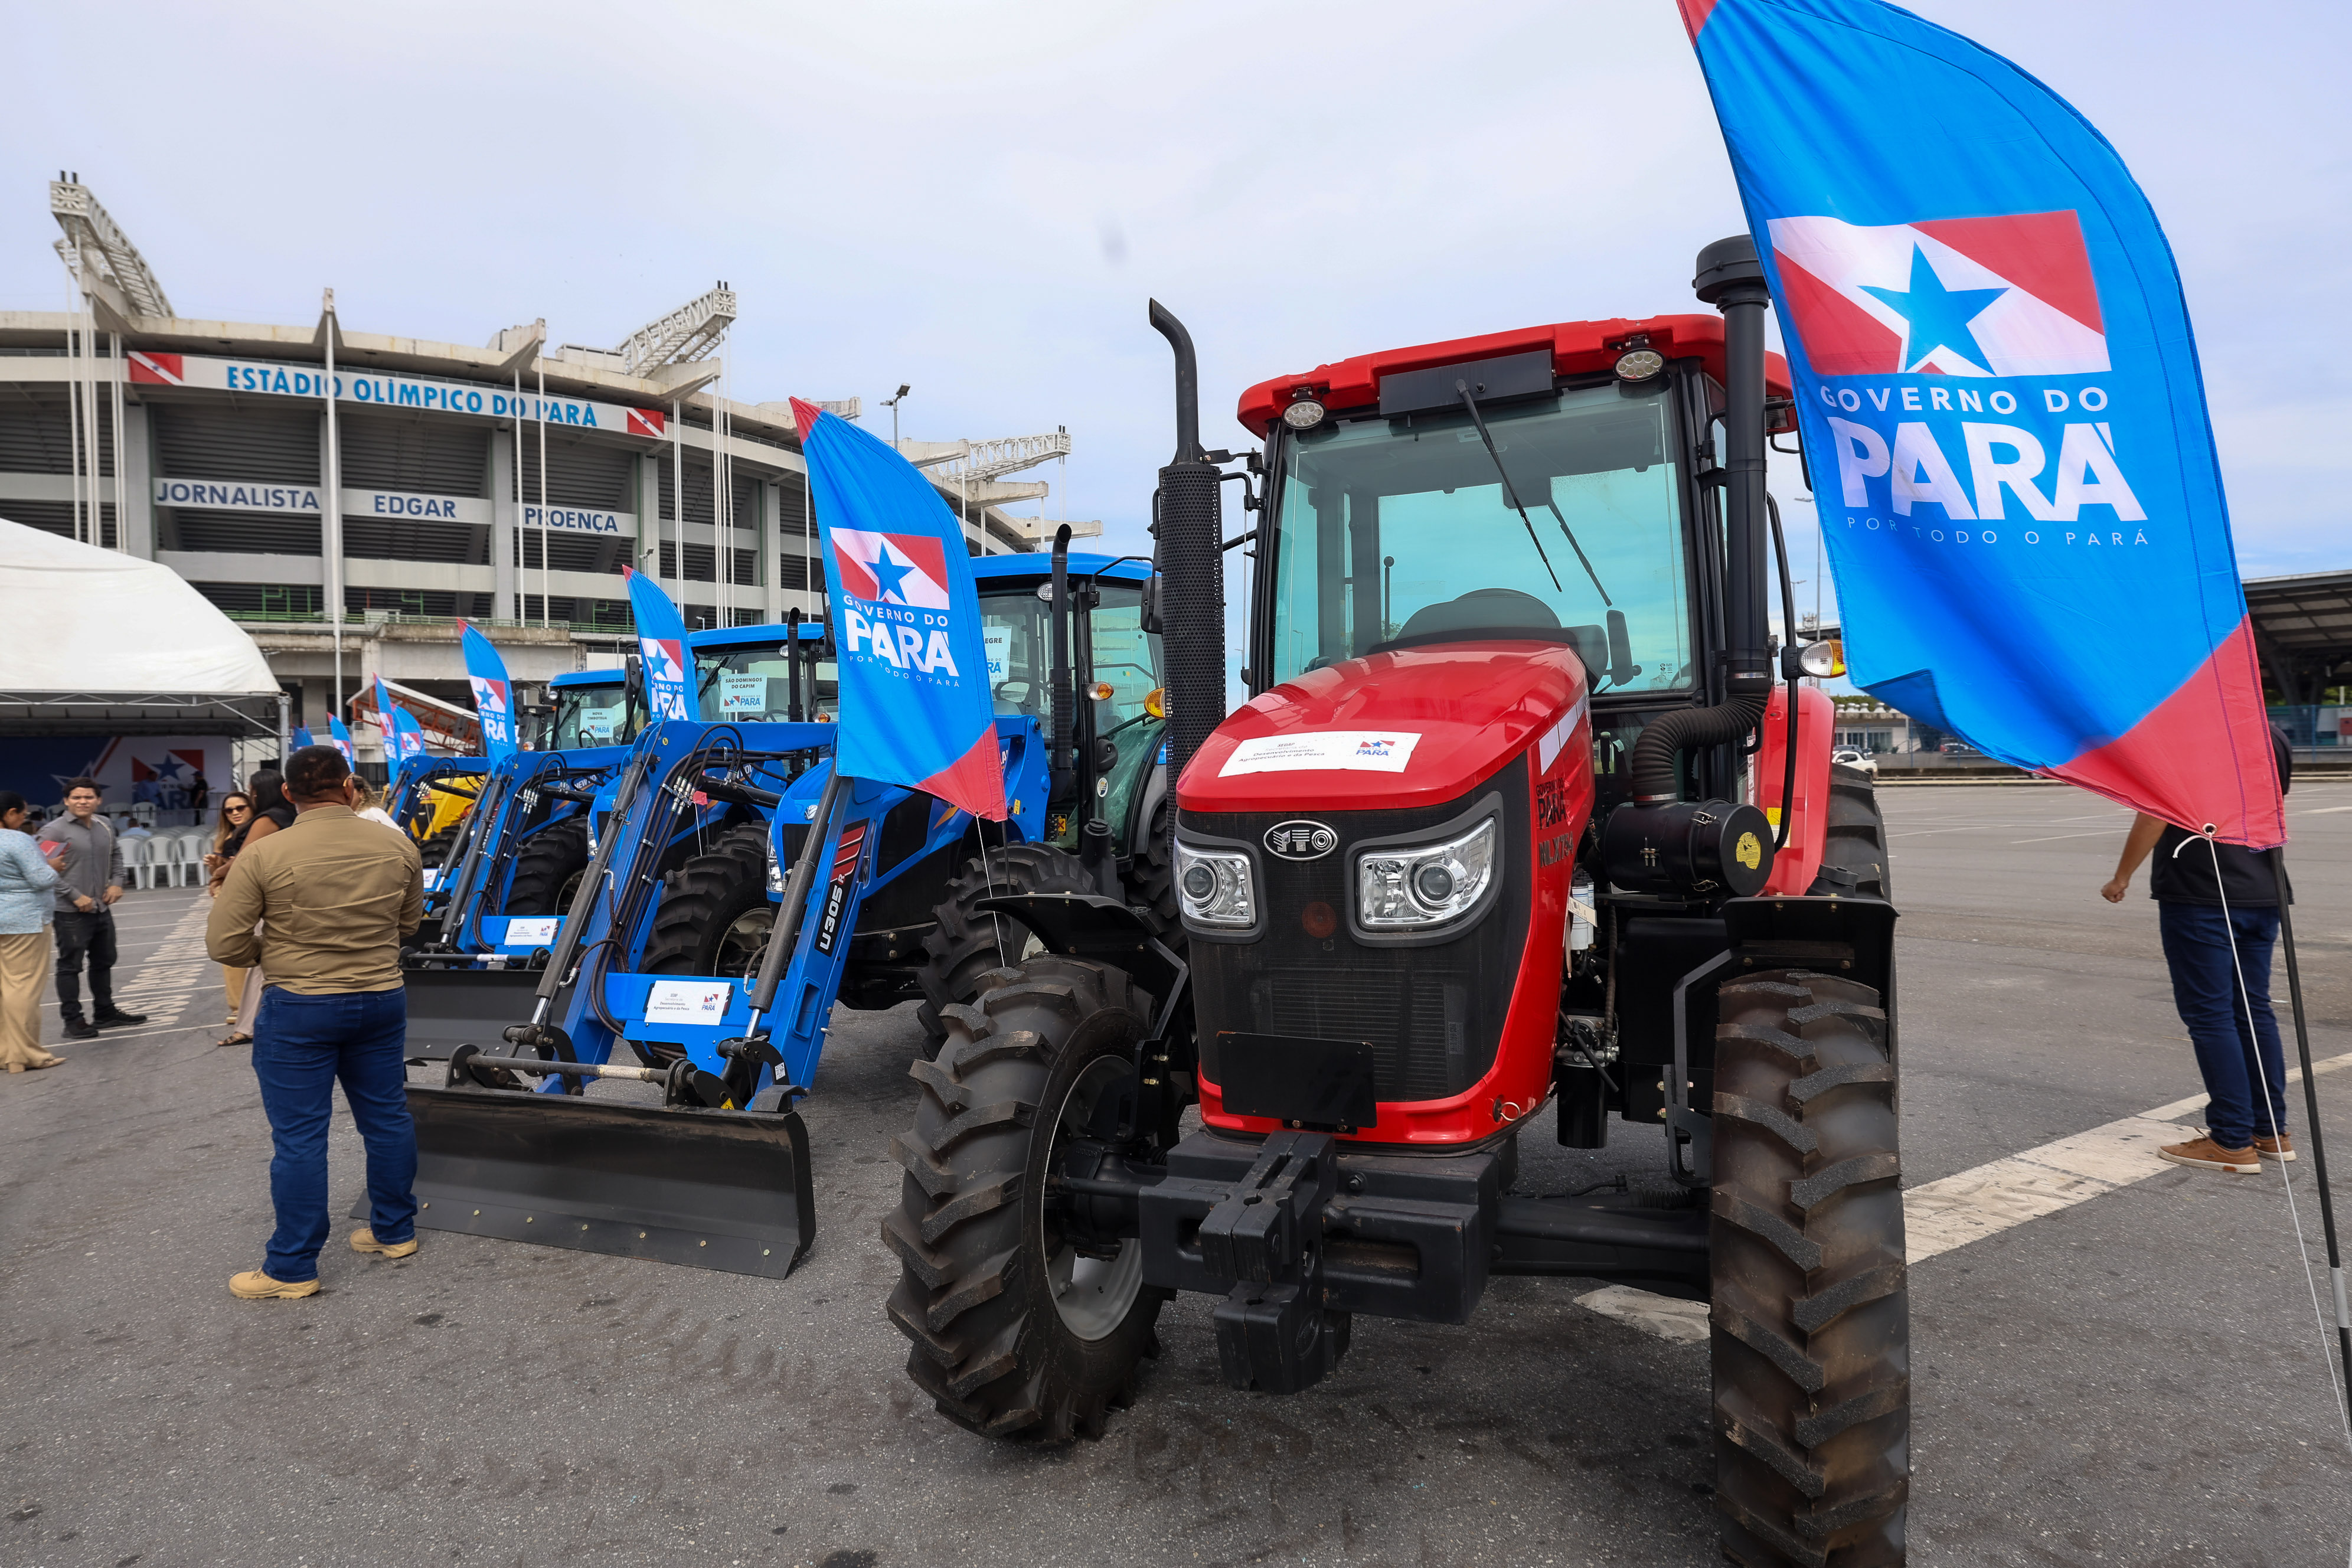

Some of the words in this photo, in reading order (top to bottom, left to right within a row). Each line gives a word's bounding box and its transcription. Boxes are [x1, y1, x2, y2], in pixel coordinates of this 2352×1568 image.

[227, 366, 342, 398] ESTÁDIO
[354, 378, 483, 413] OLÍMPICO
[492, 394, 526, 418] DO
[535, 400, 597, 427] PARÁ
[1819, 385, 2017, 414] GOVERNO
[2044, 386, 2109, 412] DO
[1827, 416, 2148, 522] PARÁ
[156, 482, 320, 509] JORNALISTA
[374, 494, 457, 518] EDGAR
[525, 507, 618, 533] PROENÇA
[1848, 516, 1899, 532] POR
[1912, 525, 1998, 545] TODO
[2024, 530, 2040, 545] O
[2066, 528, 2149, 546] PARÁ
[843, 594, 915, 623] GOVERNO
[924, 613, 949, 627] DO
[844, 609, 959, 677] PARÁ
[849, 655, 873, 664] POR
[929, 677, 960, 688] PARÁ
[987, 662, 1002, 674] RÁ
[1273, 829, 1332, 852] YTO
